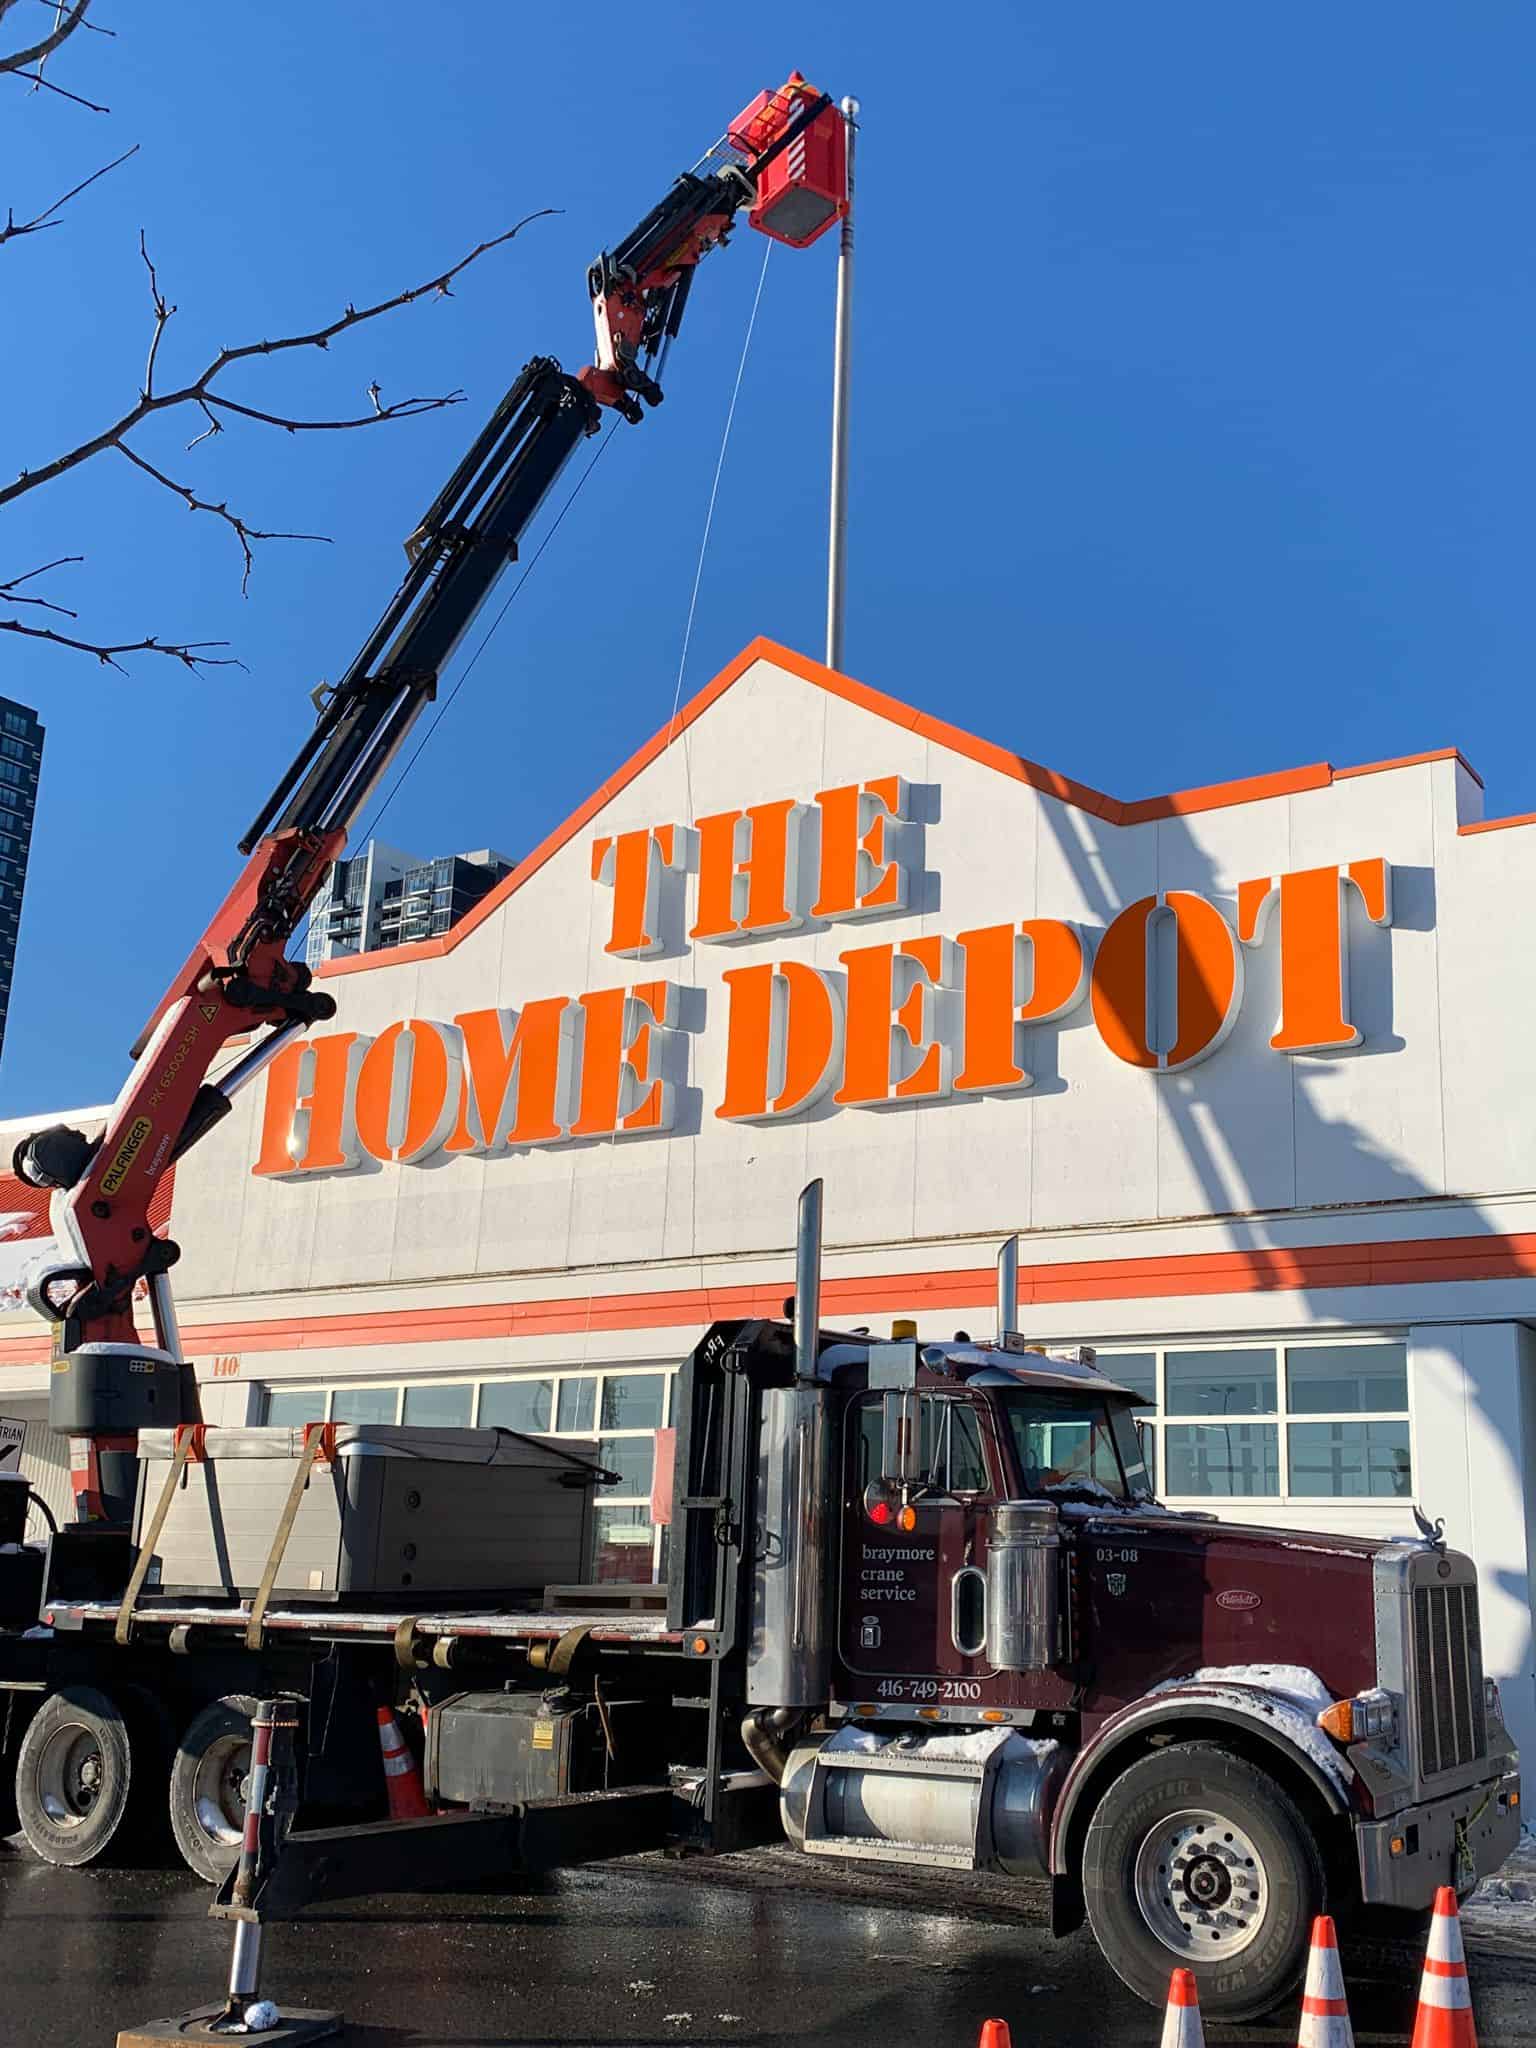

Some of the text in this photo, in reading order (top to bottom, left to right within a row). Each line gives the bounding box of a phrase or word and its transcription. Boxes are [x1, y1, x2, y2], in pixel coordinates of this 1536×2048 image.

[592, 775, 906, 957] THE
[252, 857, 1391, 1178] HOME DEPOT
[103, 1120, 150, 1192] PALFINGER
[212, 1356, 240, 1377] 140
[862, 1544, 935, 1563] braymore
[1096, 1548, 1138, 1562] 03-08
[861, 1569, 905, 1581] crane
[860, 1585, 916, 1601] service
[877, 1679, 981, 1700] 416-749-2100
